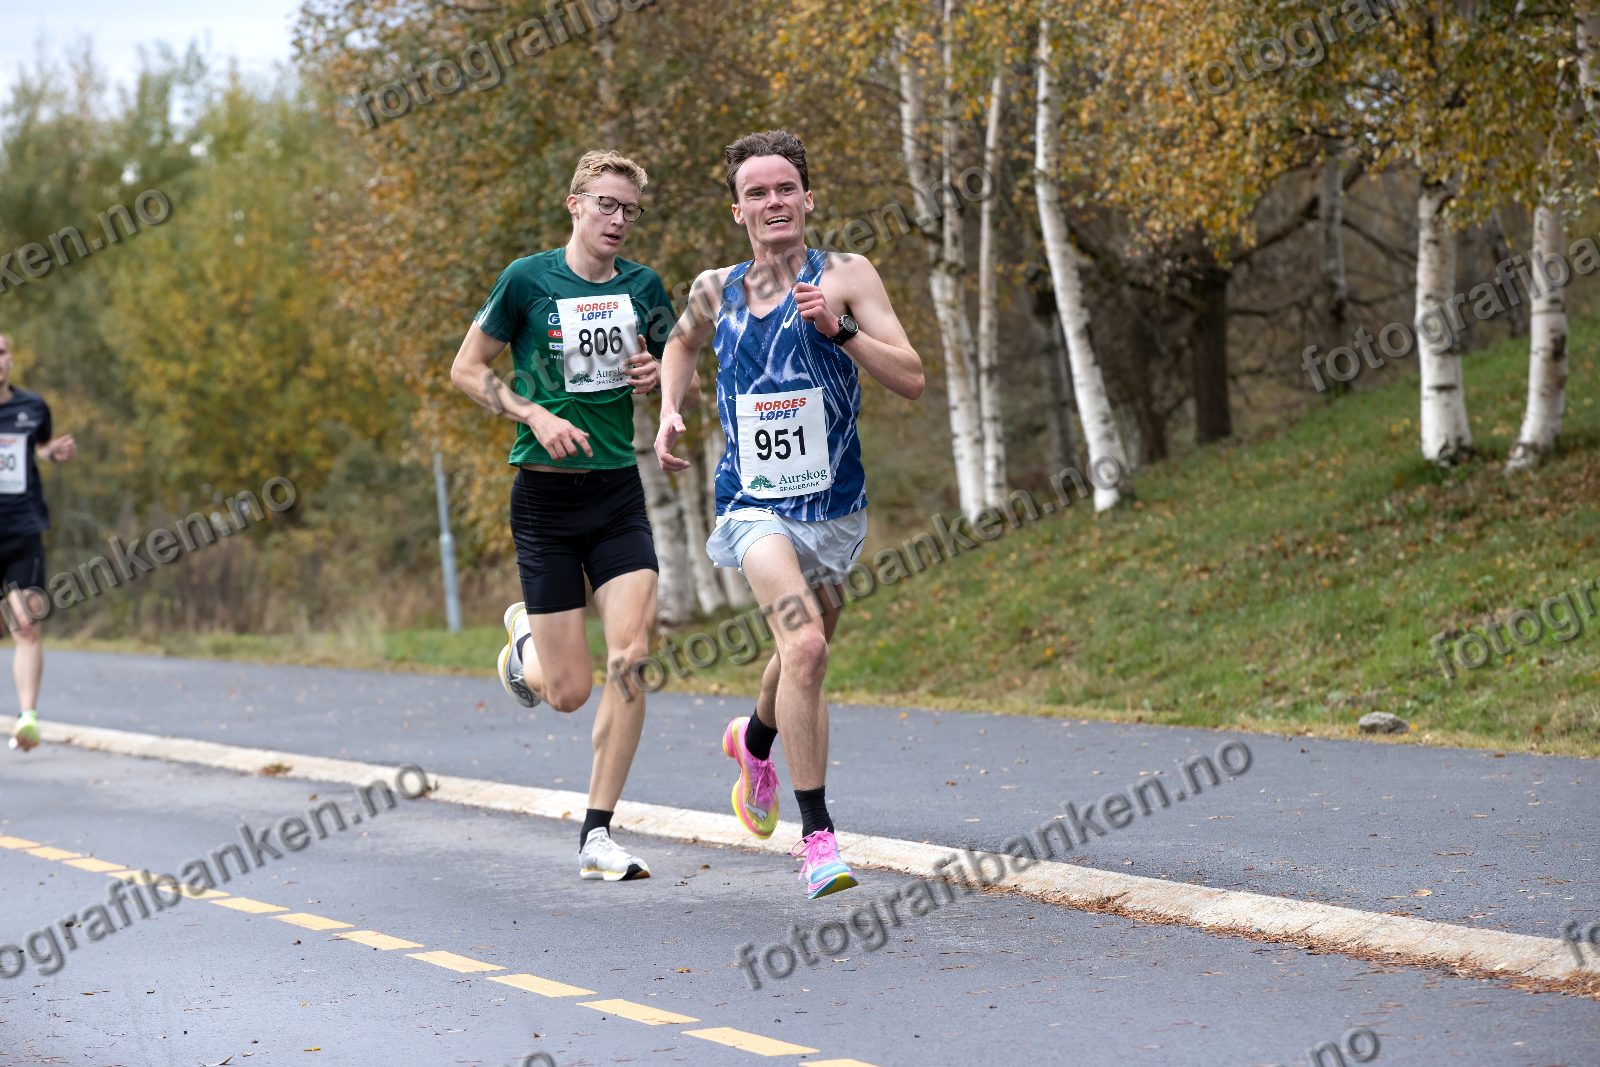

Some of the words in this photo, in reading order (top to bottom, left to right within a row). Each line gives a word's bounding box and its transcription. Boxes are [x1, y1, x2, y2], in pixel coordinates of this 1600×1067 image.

[575, 301, 619, 313] NORGES
[581, 310, 613, 321] LØPET
[578, 326, 623, 357] 806
[596, 366, 626, 378] Aursk
[753, 397, 807, 412] NORGES
[759, 408, 799, 422] LØPET
[754, 425, 806, 461] 951
[779, 469, 828, 484] Aurskog
